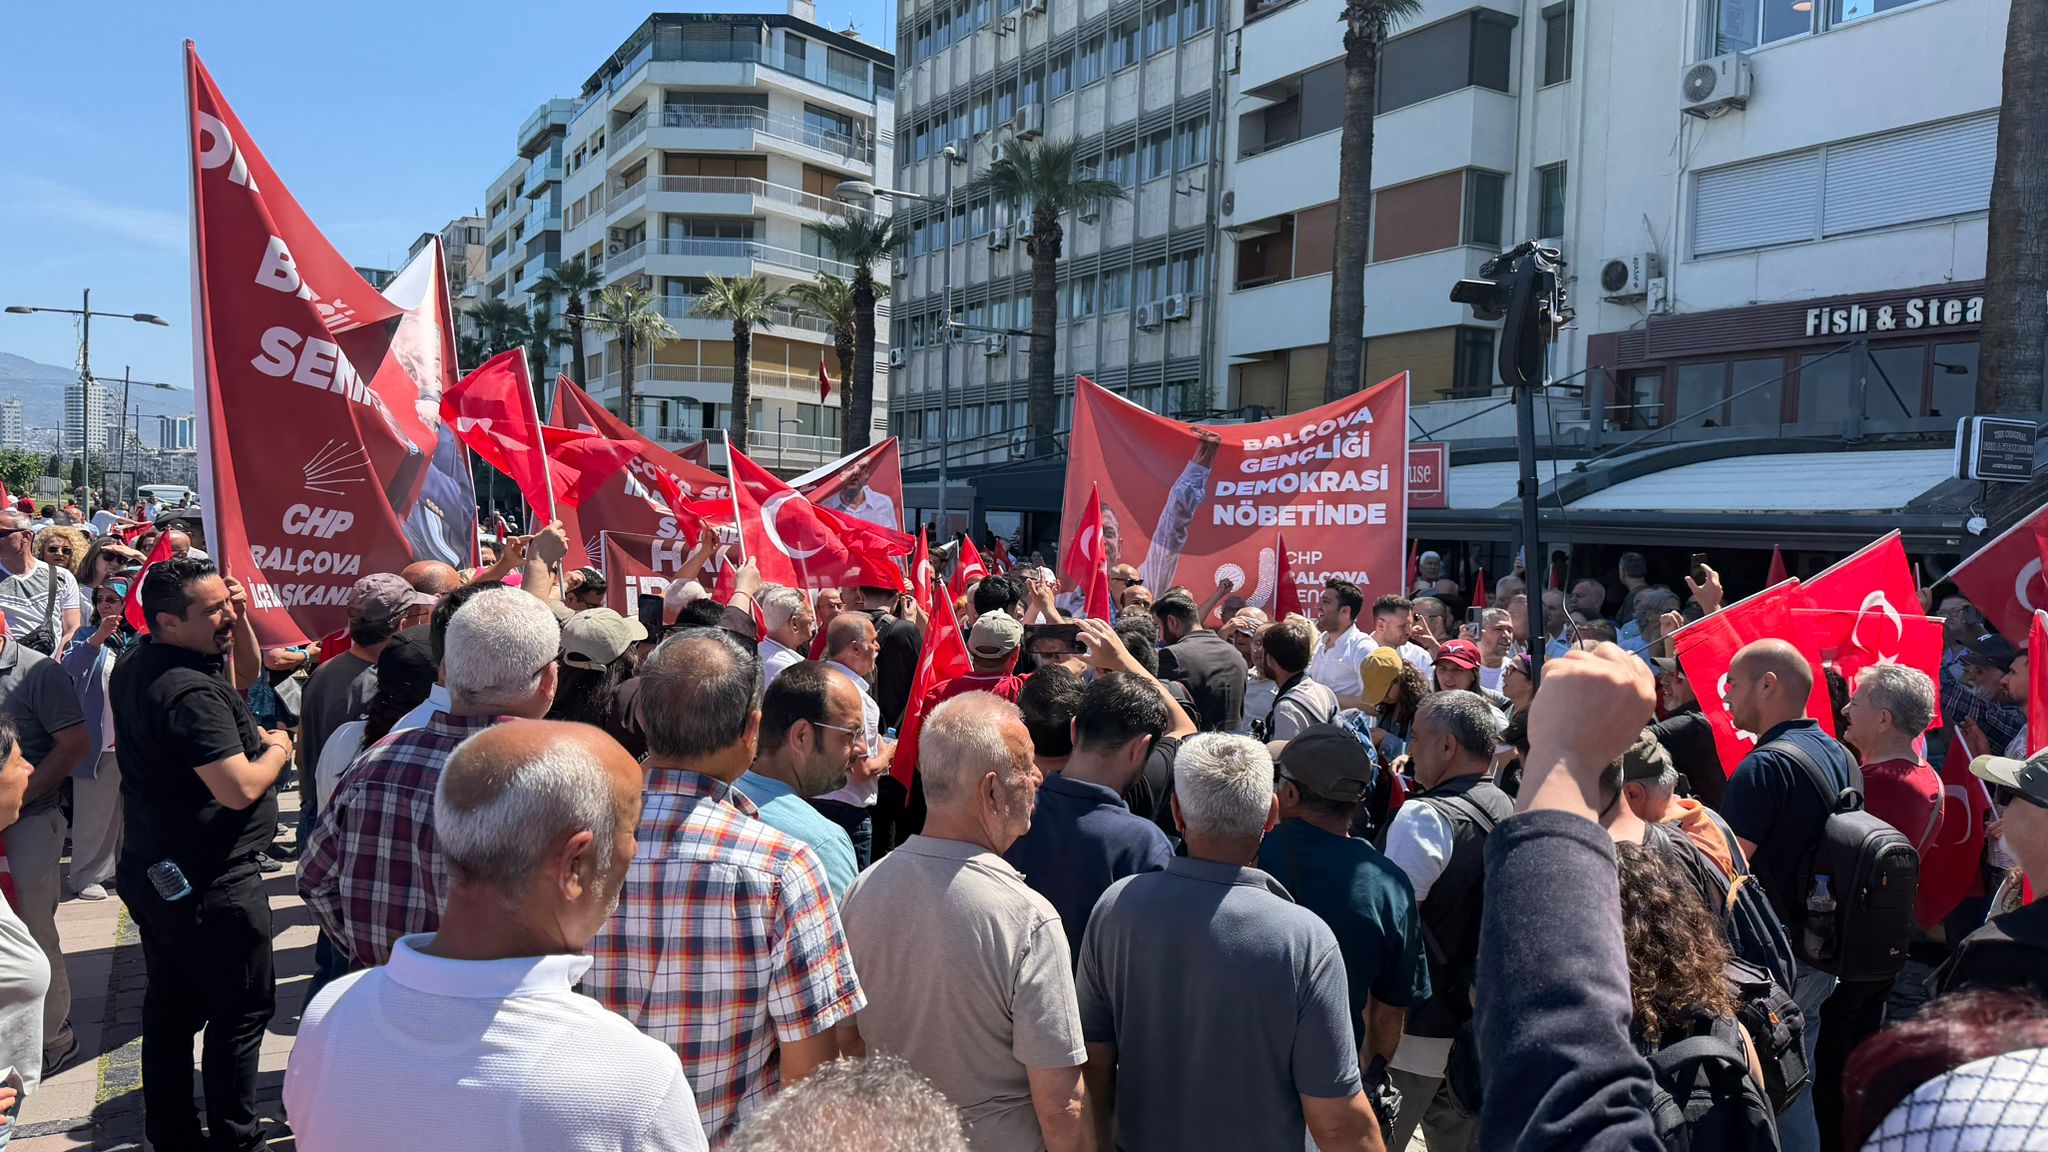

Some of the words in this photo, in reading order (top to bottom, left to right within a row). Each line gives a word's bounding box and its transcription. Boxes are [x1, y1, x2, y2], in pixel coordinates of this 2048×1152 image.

[1805, 304, 1868, 337] Fish
[1876, 305, 1896, 331] &
[1242, 406, 1374, 451] BALÇOVA
[1240, 431, 1370, 474] GENÇLİĞİ
[1215, 464, 1389, 497] DEMOKRASİ
[282, 503, 354, 539] CHP
[1212, 500, 1387, 527] NÖBETİNDE
[250, 544, 361, 576] BALÇOVA
[1286, 550, 1323, 565] CHP
